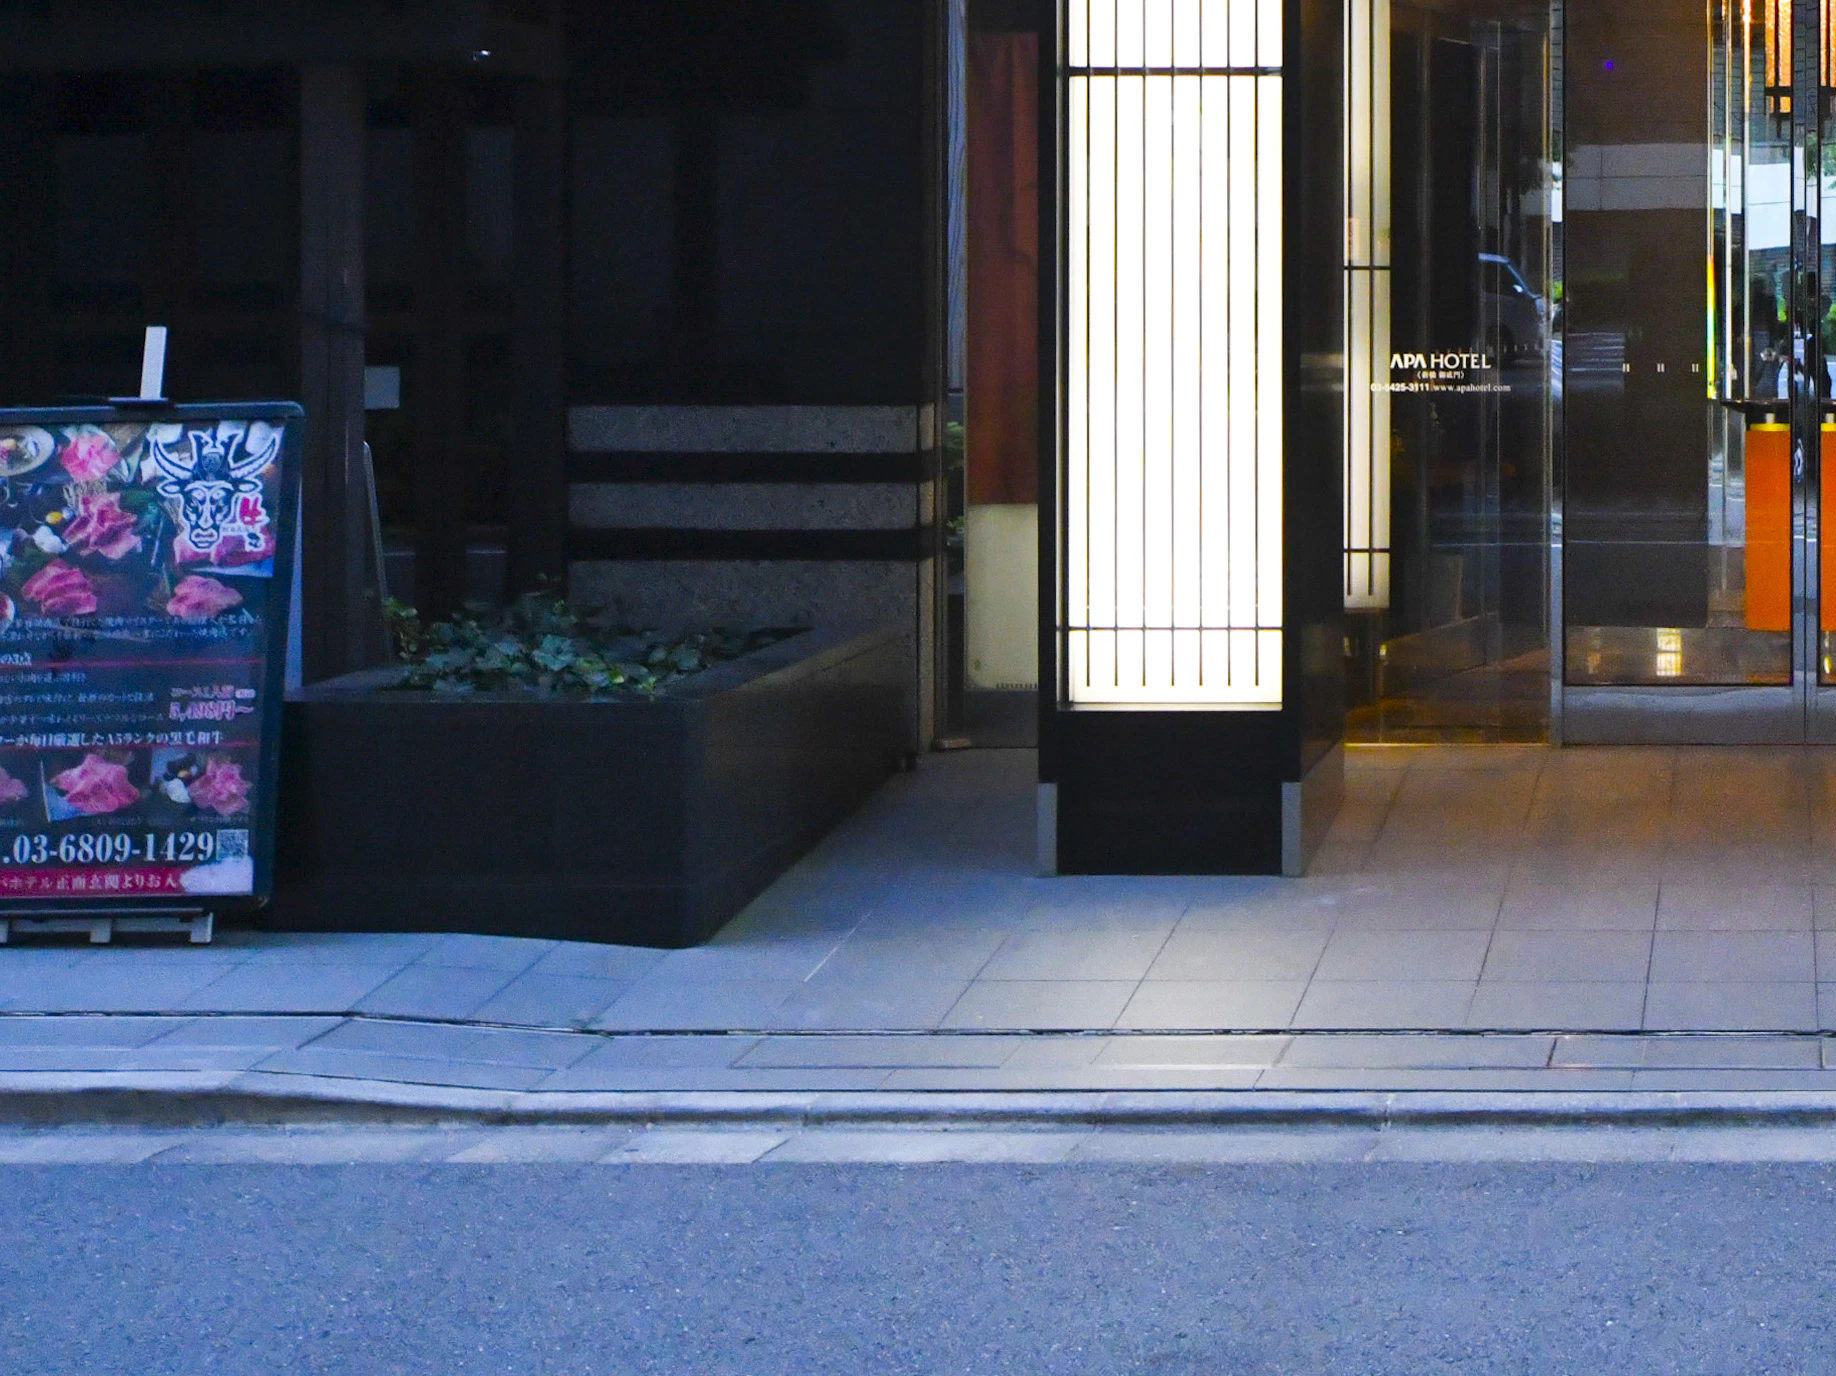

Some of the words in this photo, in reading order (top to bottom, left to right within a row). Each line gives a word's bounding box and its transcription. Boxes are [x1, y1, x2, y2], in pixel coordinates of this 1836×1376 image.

[1390, 353, 1427, 369] APA
[1430, 353, 1492, 369] HOTEL
[1433, 383, 1512, 394] www.apahotel.com
